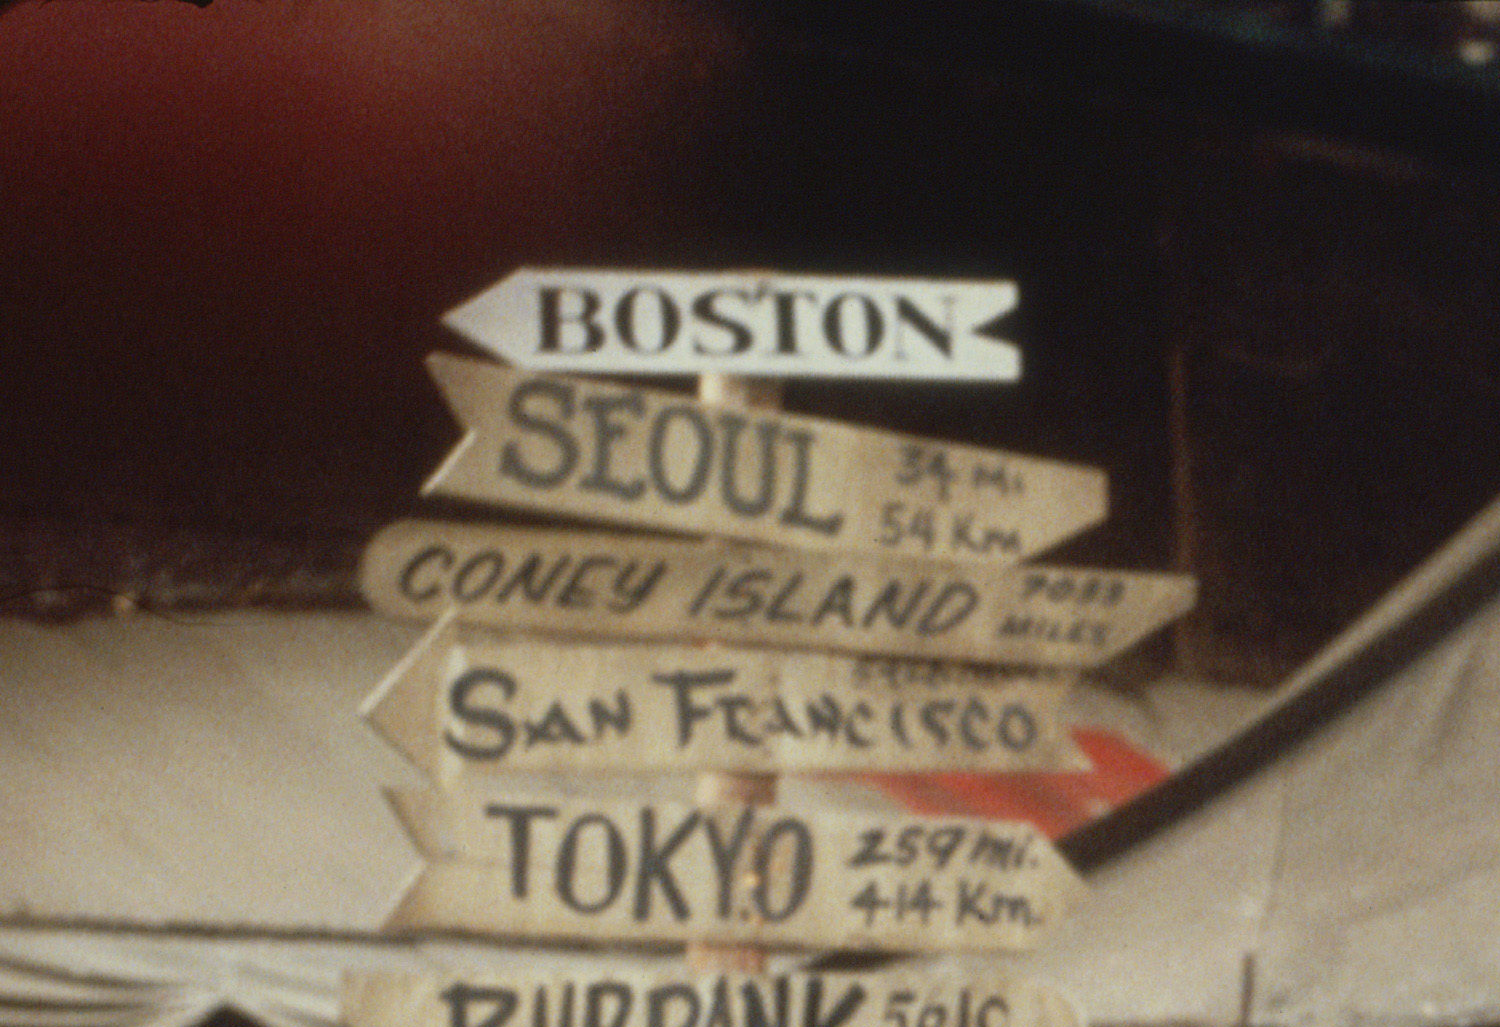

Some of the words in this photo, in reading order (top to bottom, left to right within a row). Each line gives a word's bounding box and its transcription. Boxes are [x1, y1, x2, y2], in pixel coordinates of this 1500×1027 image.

[537, 284, 956, 361] BOSTON
[500, 377, 844, 537] SEOUL
[880, 500, 936, 550] 54
[400, 545, 668, 616] CONEY
[689, 566, 981, 637] ISLAND
[484, 803, 815, 923] TOKYO
[848, 825, 967, 869] 259
[850, 877, 946, 927] 414
